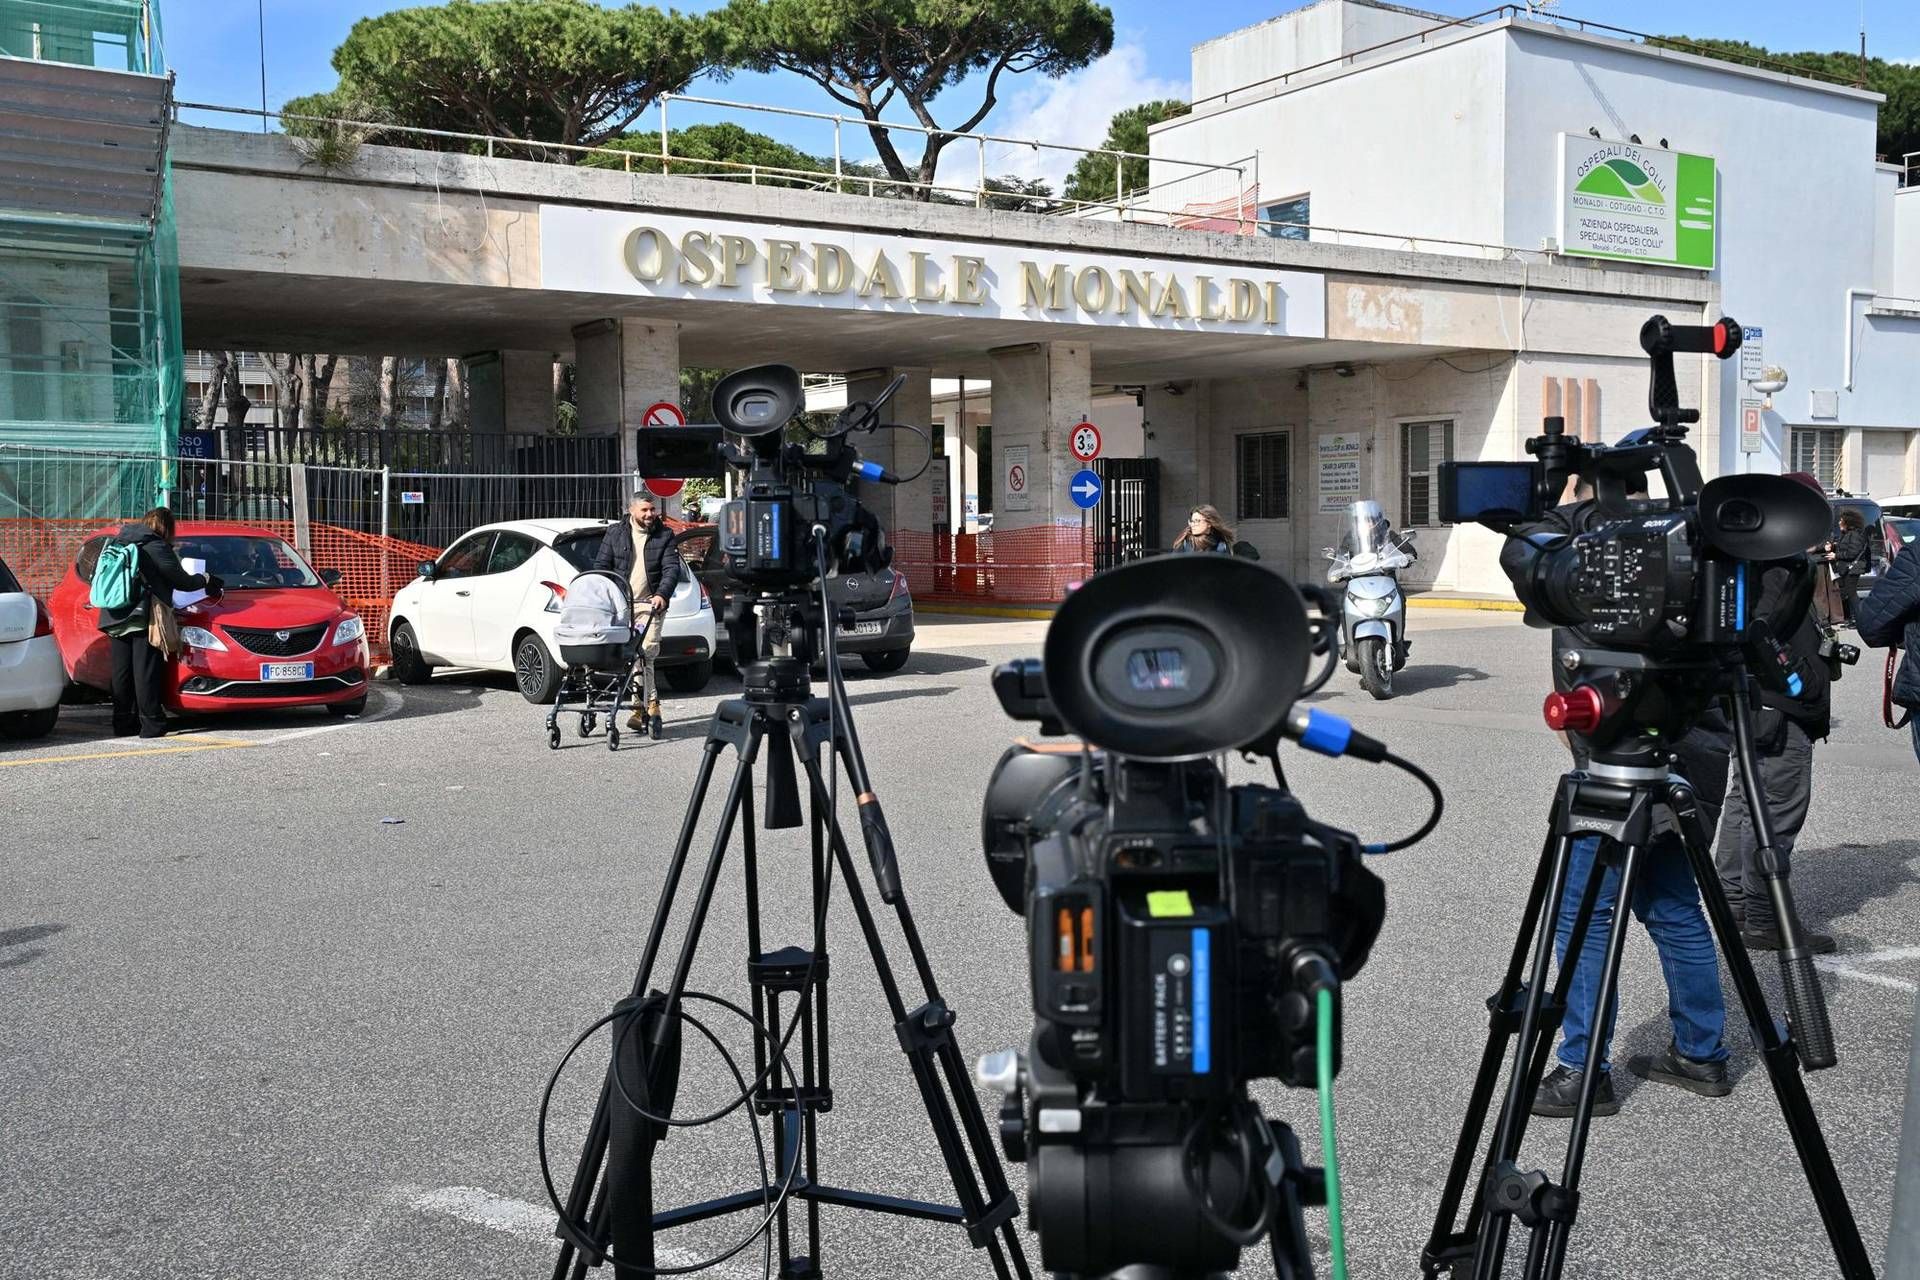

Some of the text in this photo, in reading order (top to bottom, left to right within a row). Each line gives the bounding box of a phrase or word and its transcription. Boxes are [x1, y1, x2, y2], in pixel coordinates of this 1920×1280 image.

[1577, 146, 1666, 193] OSPEDALI DEI COLLI
[1573, 196, 1603, 207] MONALDI
[1610, 201, 1641, 212] COTUGNO
[1614, 222, 1659, 236] OSPEDALIERA
[1580, 231, 1628, 244] SPECIALISTICA
[1630, 237, 1641, 246] DEI
[623, 226, 1281, 326] OSPEDALE MONALDI
[1747, 411, 1755, 430] P
[1078, 435, 1085, 450] 3
[1642, 519, 1672, 528] SONY
[1154, 973, 1167, 1066] BATTERY PACK
